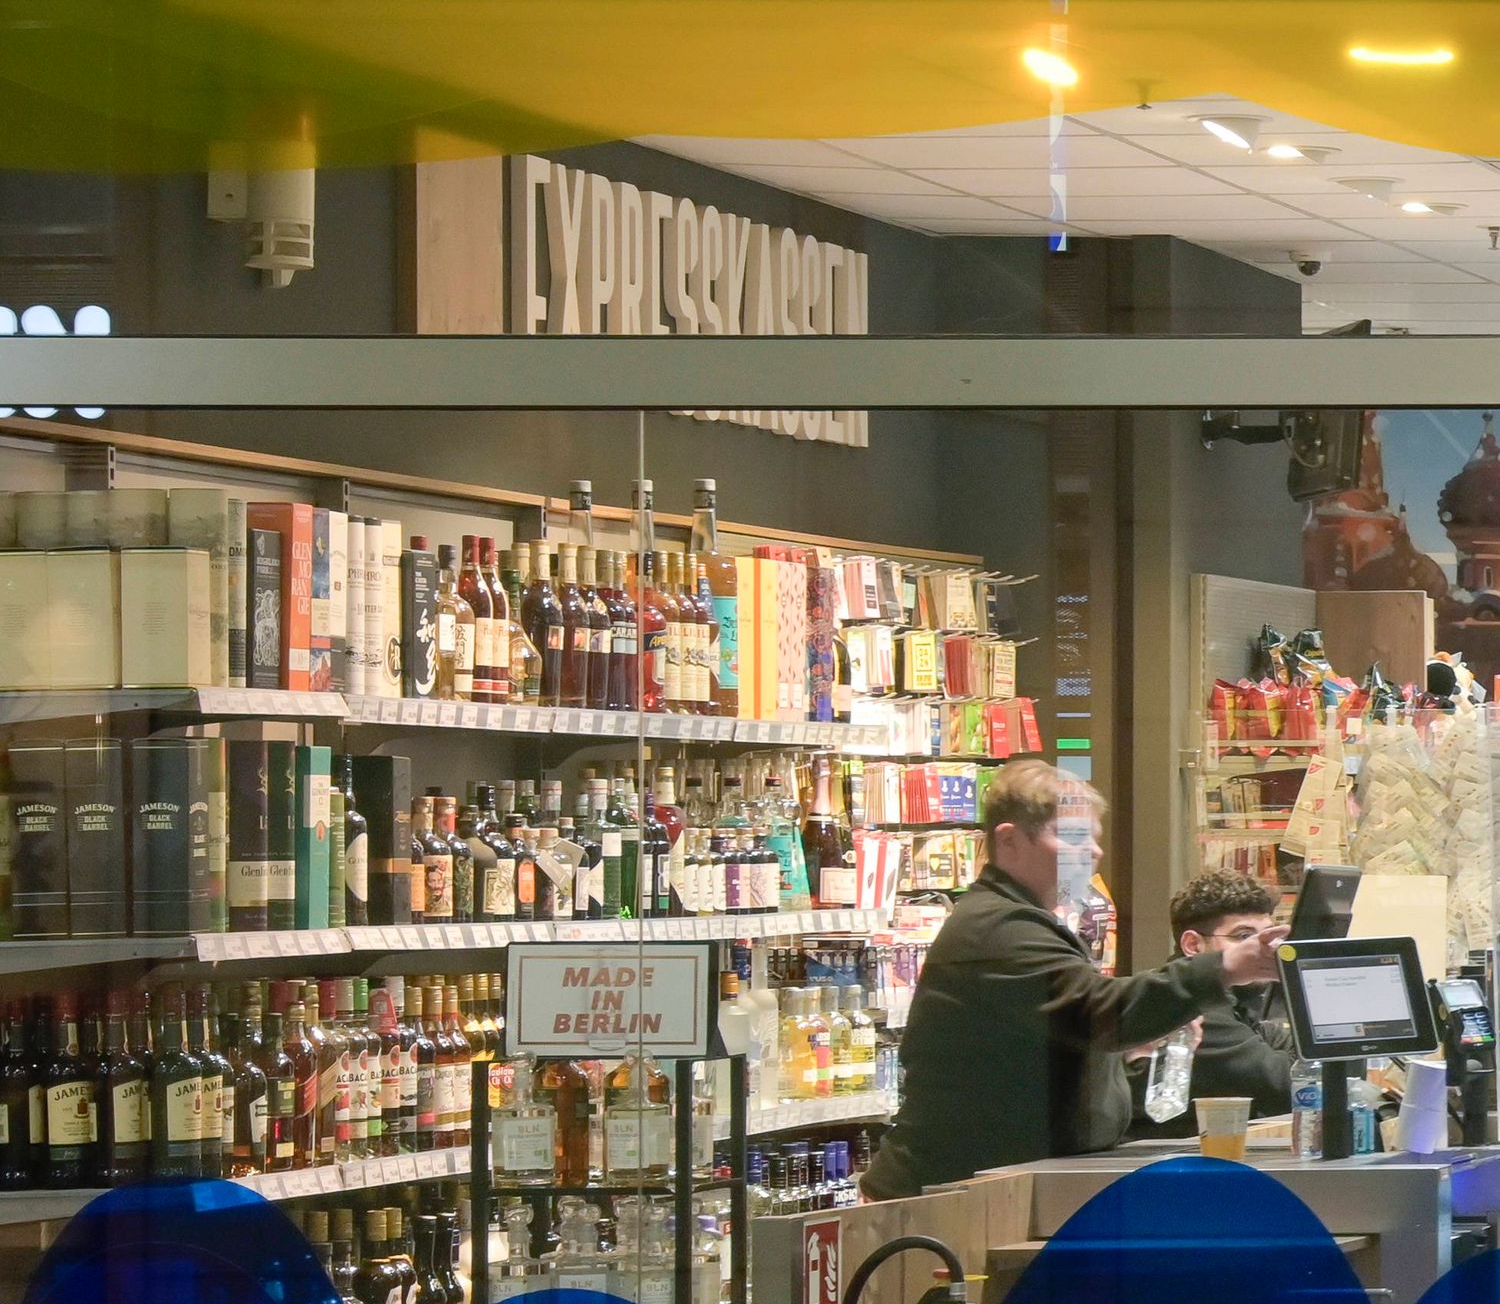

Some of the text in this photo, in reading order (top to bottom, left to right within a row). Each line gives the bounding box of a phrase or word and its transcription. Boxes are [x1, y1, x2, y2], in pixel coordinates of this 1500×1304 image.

[16, 804, 59, 816] JAMESON
[74, 803, 116, 815] JAMESON
[139, 802, 180, 814] JAMESON
[562, 966, 655, 988] MADE
[591, 990, 625, 1011] IN
[553, 1013, 663, 1034] BERLIN
